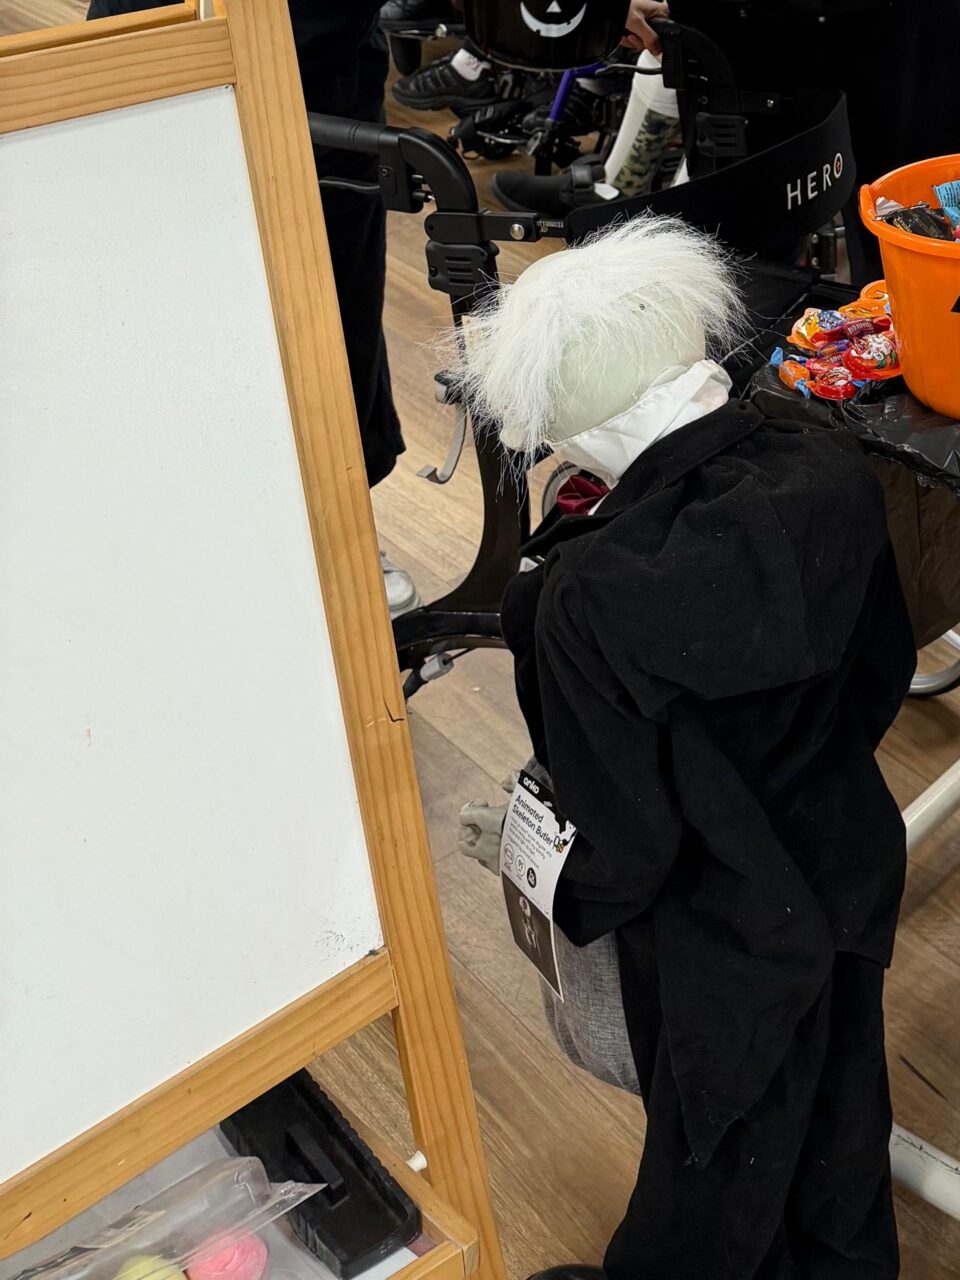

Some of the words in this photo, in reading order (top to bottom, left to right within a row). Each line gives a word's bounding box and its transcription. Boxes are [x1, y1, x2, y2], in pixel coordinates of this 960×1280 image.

[786, 152, 843, 211] HERO
[523, 777, 540, 795] anko
[512, 804, 536, 831] Skeleton
[535, 825, 554, 846] Butler
[515, 794, 545, 823] Animated
